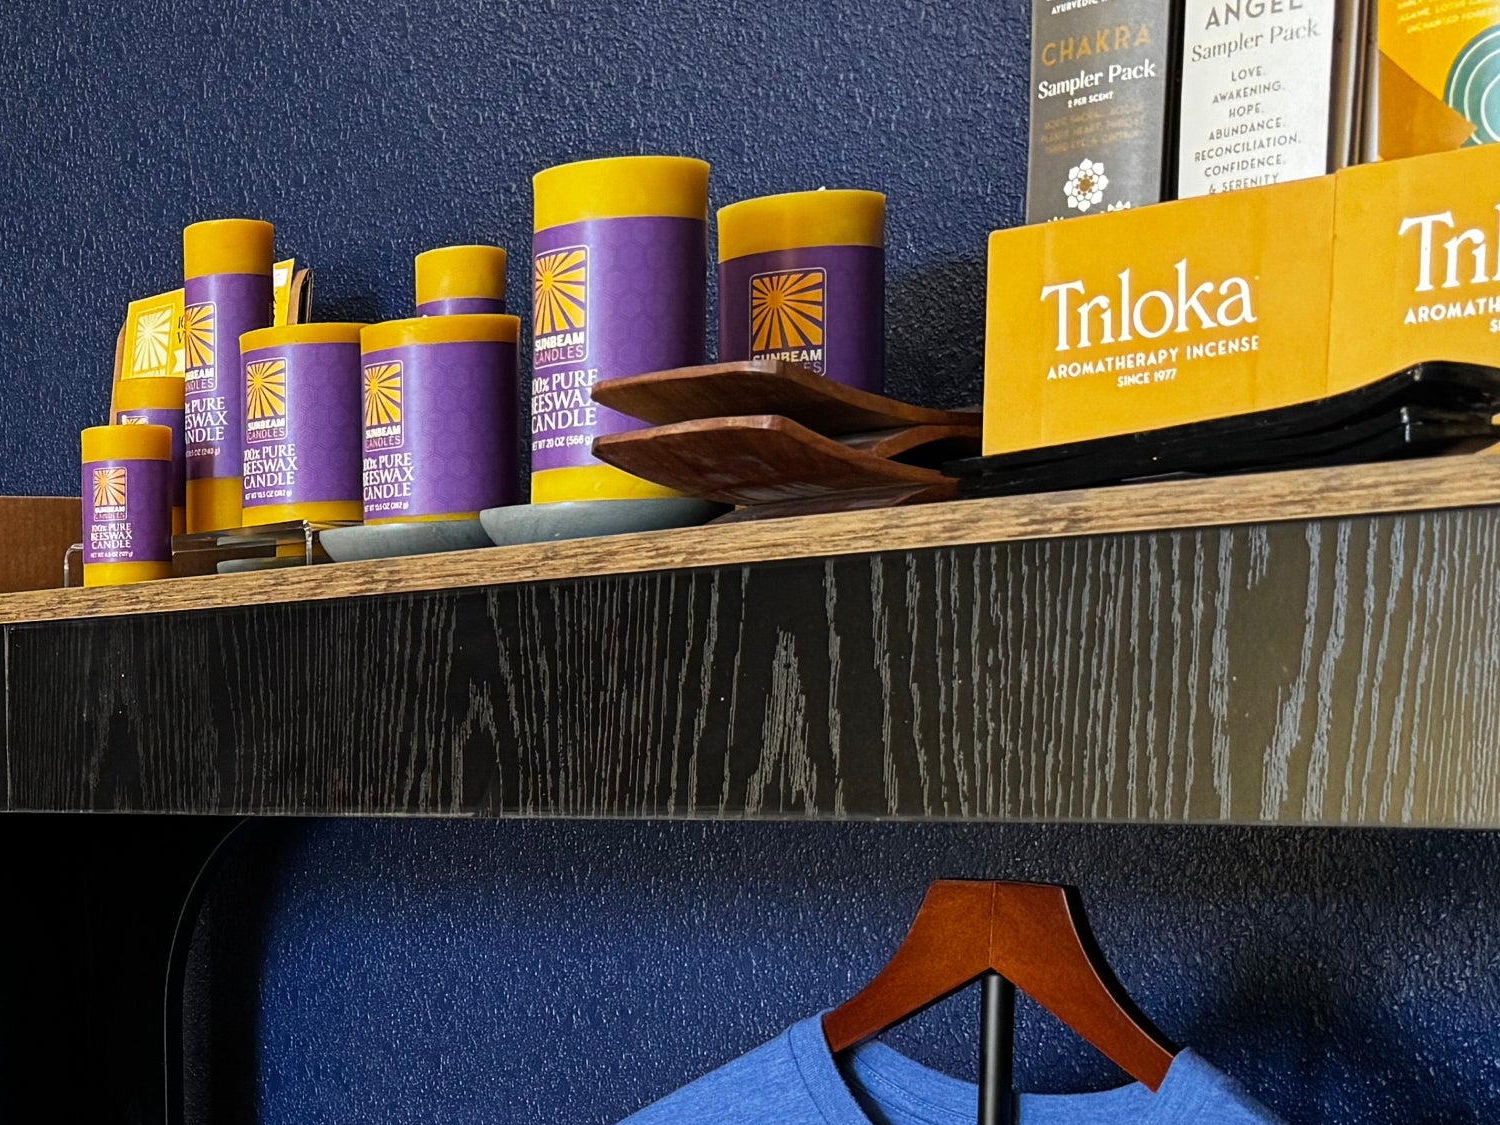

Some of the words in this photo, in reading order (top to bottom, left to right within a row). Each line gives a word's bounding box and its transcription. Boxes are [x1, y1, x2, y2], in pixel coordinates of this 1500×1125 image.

[1205, 0, 1303, 30] ANGEL
[1041, 23, 1153, 67] CHAKRA
[1191, 32, 1264, 62] Sampler
[1269, 18, 1320, 44] Pack
[1037, 70, 1104, 100] Sampler
[1108, 59, 1156, 83] Pack
[1073, 96, 1087, 106] PER
[1088, 91, 1115, 104] SCENT
[1221, 172, 1280, 193] SERENITY
[1398, 203, 1500, 293] Tril
[1040, 257, 1258, 352] Triloka
[1404, 296, 1500, 325] AROMATH
[534, 331, 585, 352] SUNBEAM
[534, 345, 584, 365] CANDLES
[1046, 347, 1179, 381] AROMATHERAPY
[1186, 335, 1260, 360] INCENSE
[185, 378, 214, 392] NDLES
[552, 368, 599, 391] PURE
[1117, 371, 1150, 388] SINCE
[1153, 368, 1178, 383] 1977
[191, 396, 226, 414] PURE
[247, 418, 286, 431] SUNBEAM
[531, 407, 599, 435] CANDLE
[365, 424, 401, 439] SUNBEAM
[554, 436, 565, 447] OZ
[262, 443, 296, 459] PURE
[378, 452, 412, 469] PURE
[243, 456, 298, 477] BEESWAX
[243, 471, 295, 490] CANDLE
[363, 482, 412, 501] CANDLE
[90, 530, 133, 541] BEESWAX
[108, 522, 132, 532] PURE
[91, 540, 132, 550] CANDLE
